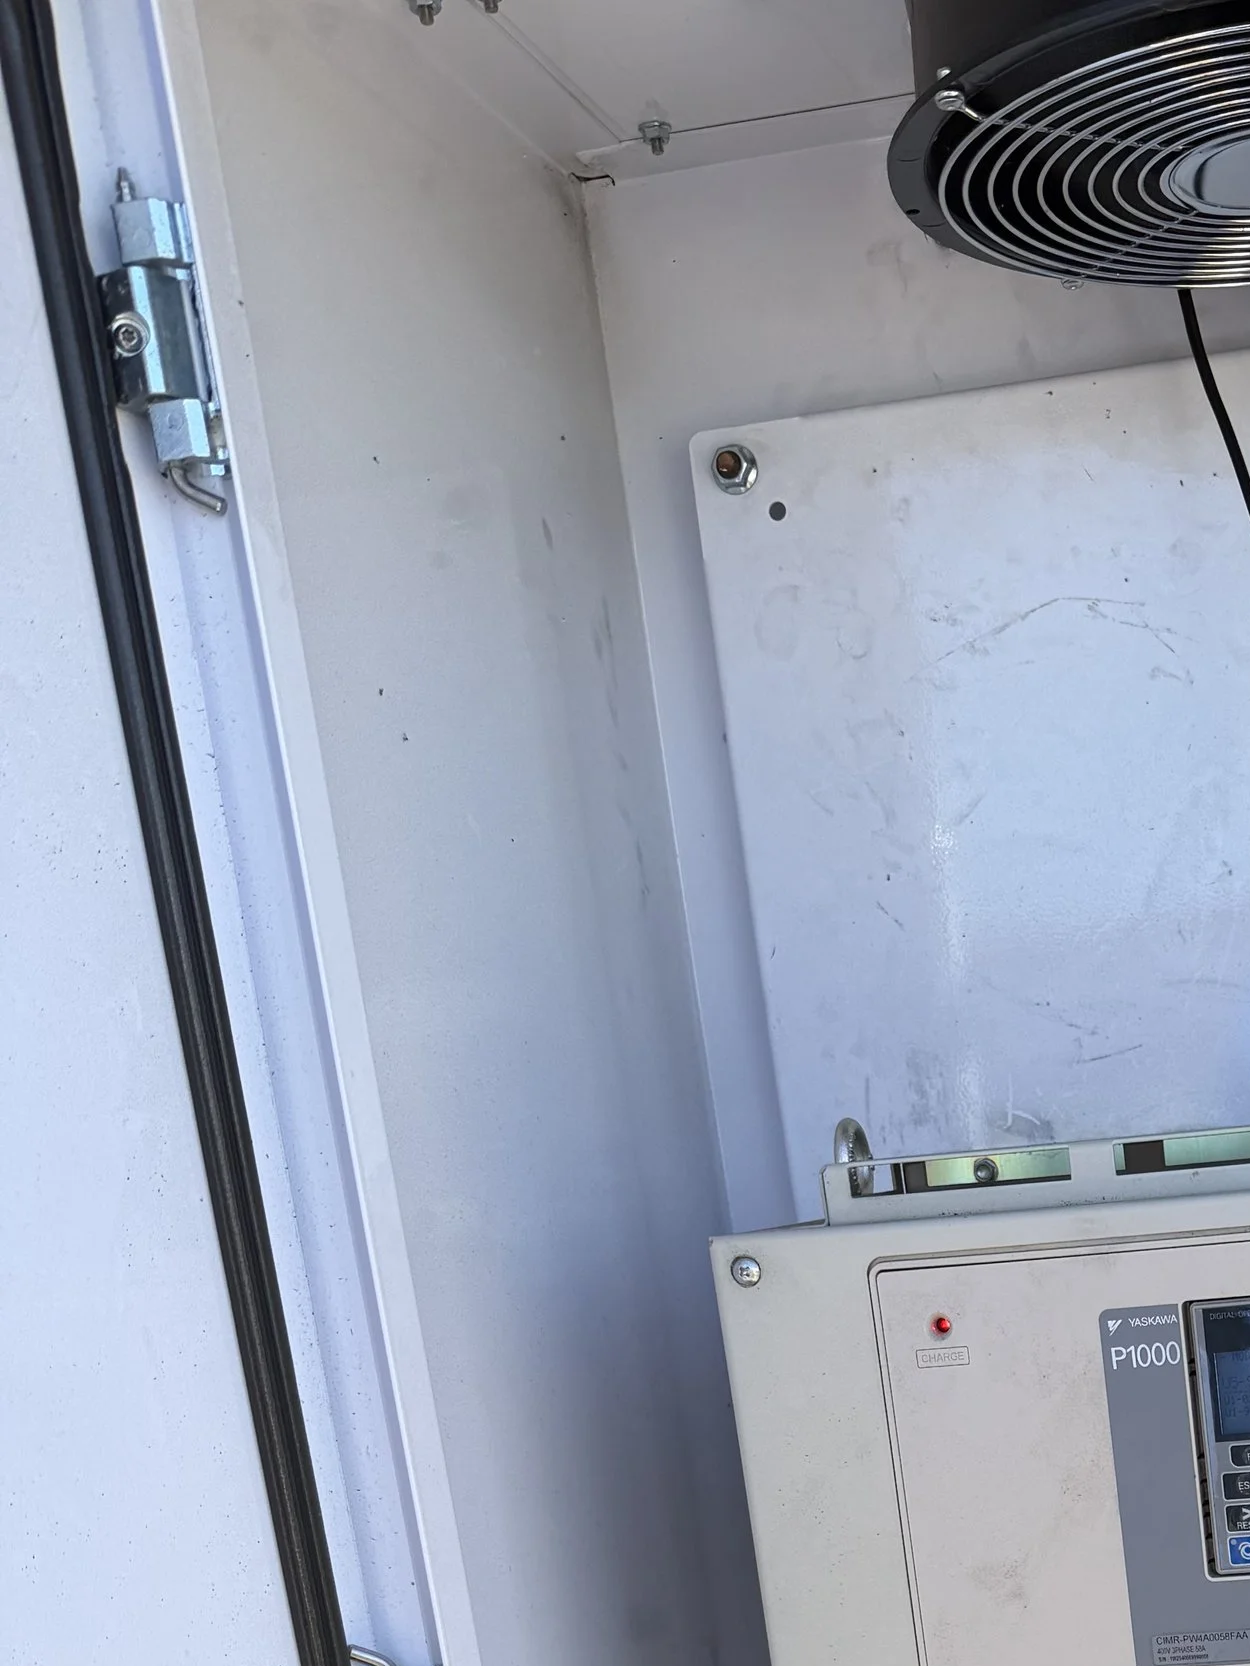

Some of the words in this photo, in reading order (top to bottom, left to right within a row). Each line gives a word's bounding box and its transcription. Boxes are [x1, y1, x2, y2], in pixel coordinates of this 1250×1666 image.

[1128, 1314, 1177, 1327] YASKAWA
[1210, 1312, 1235, 1320] DIGITAL
[921, 1351, 965, 1363] CHARGE
[1111, 1341, 1180, 1369] P1000
